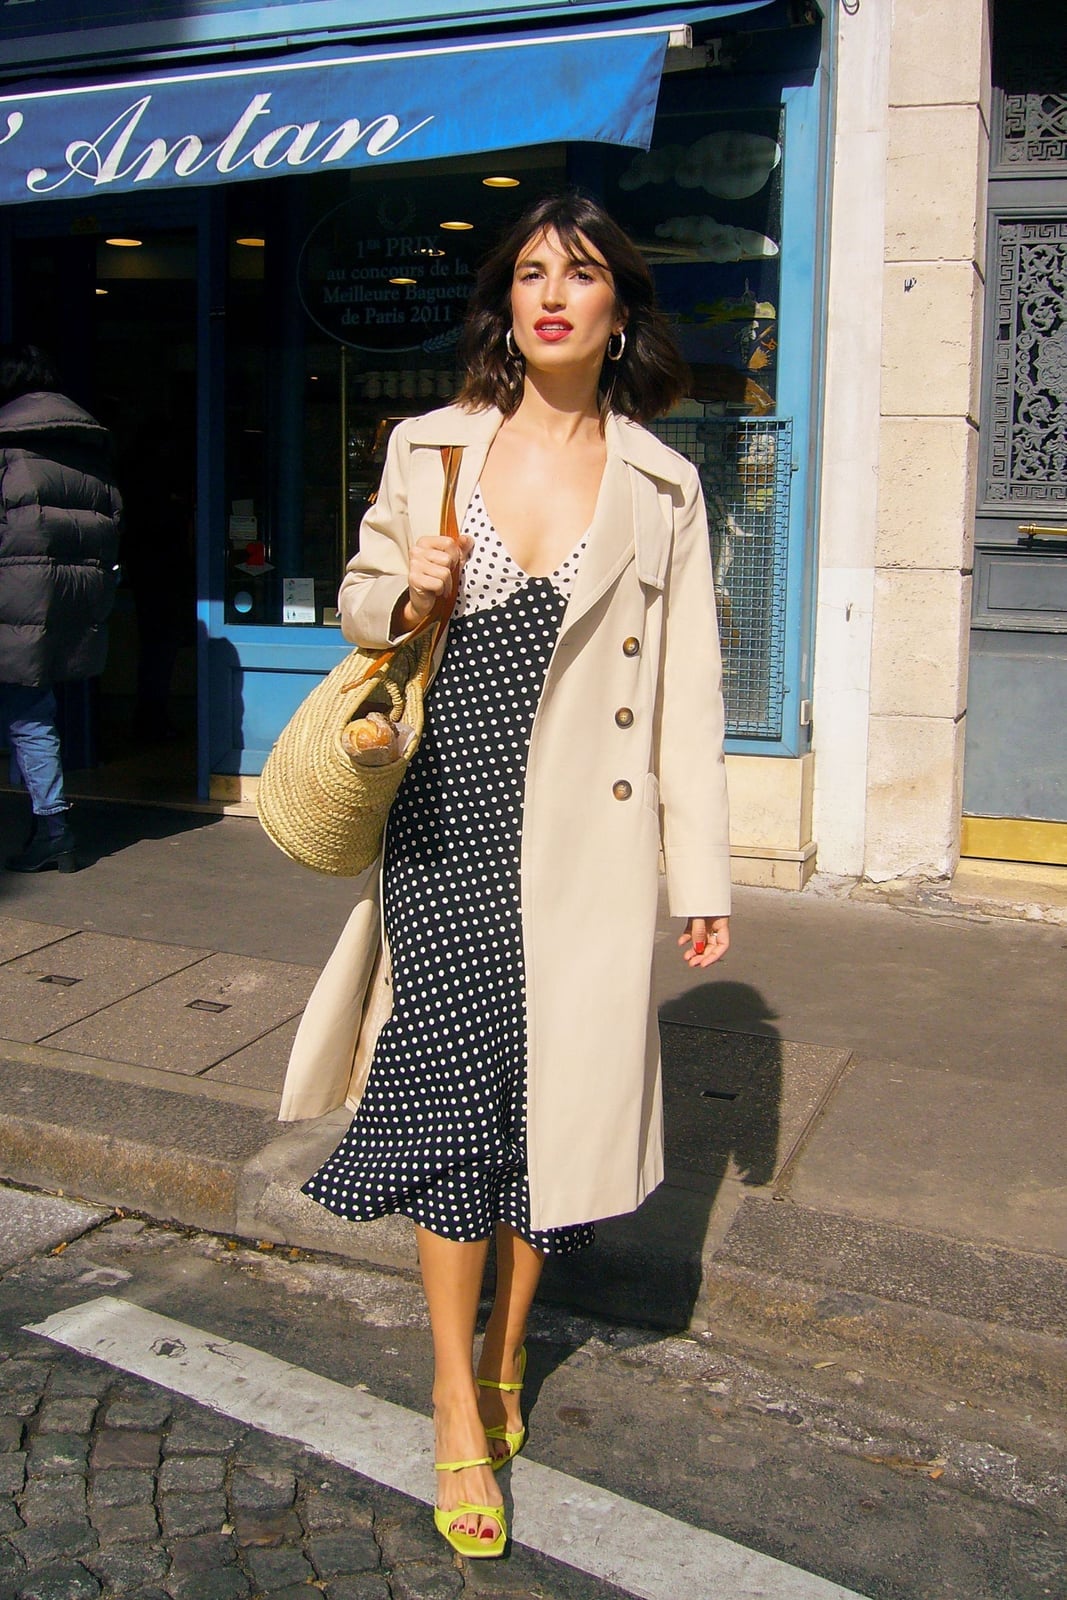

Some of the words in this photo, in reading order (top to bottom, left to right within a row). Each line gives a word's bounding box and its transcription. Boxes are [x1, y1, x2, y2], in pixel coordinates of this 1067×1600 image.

[385, 235, 440, 258] PRIX
[327, 269, 346, 281] au
[351, 264, 424, 280] concours
[430, 259, 449, 277] de
[455, 257, 469, 275] la
[323, 285, 400, 304] Meilleure
[341, 307, 360, 325] de
[364, 306, 406, 324] Paris
[410, 305, 452, 323] 2011
